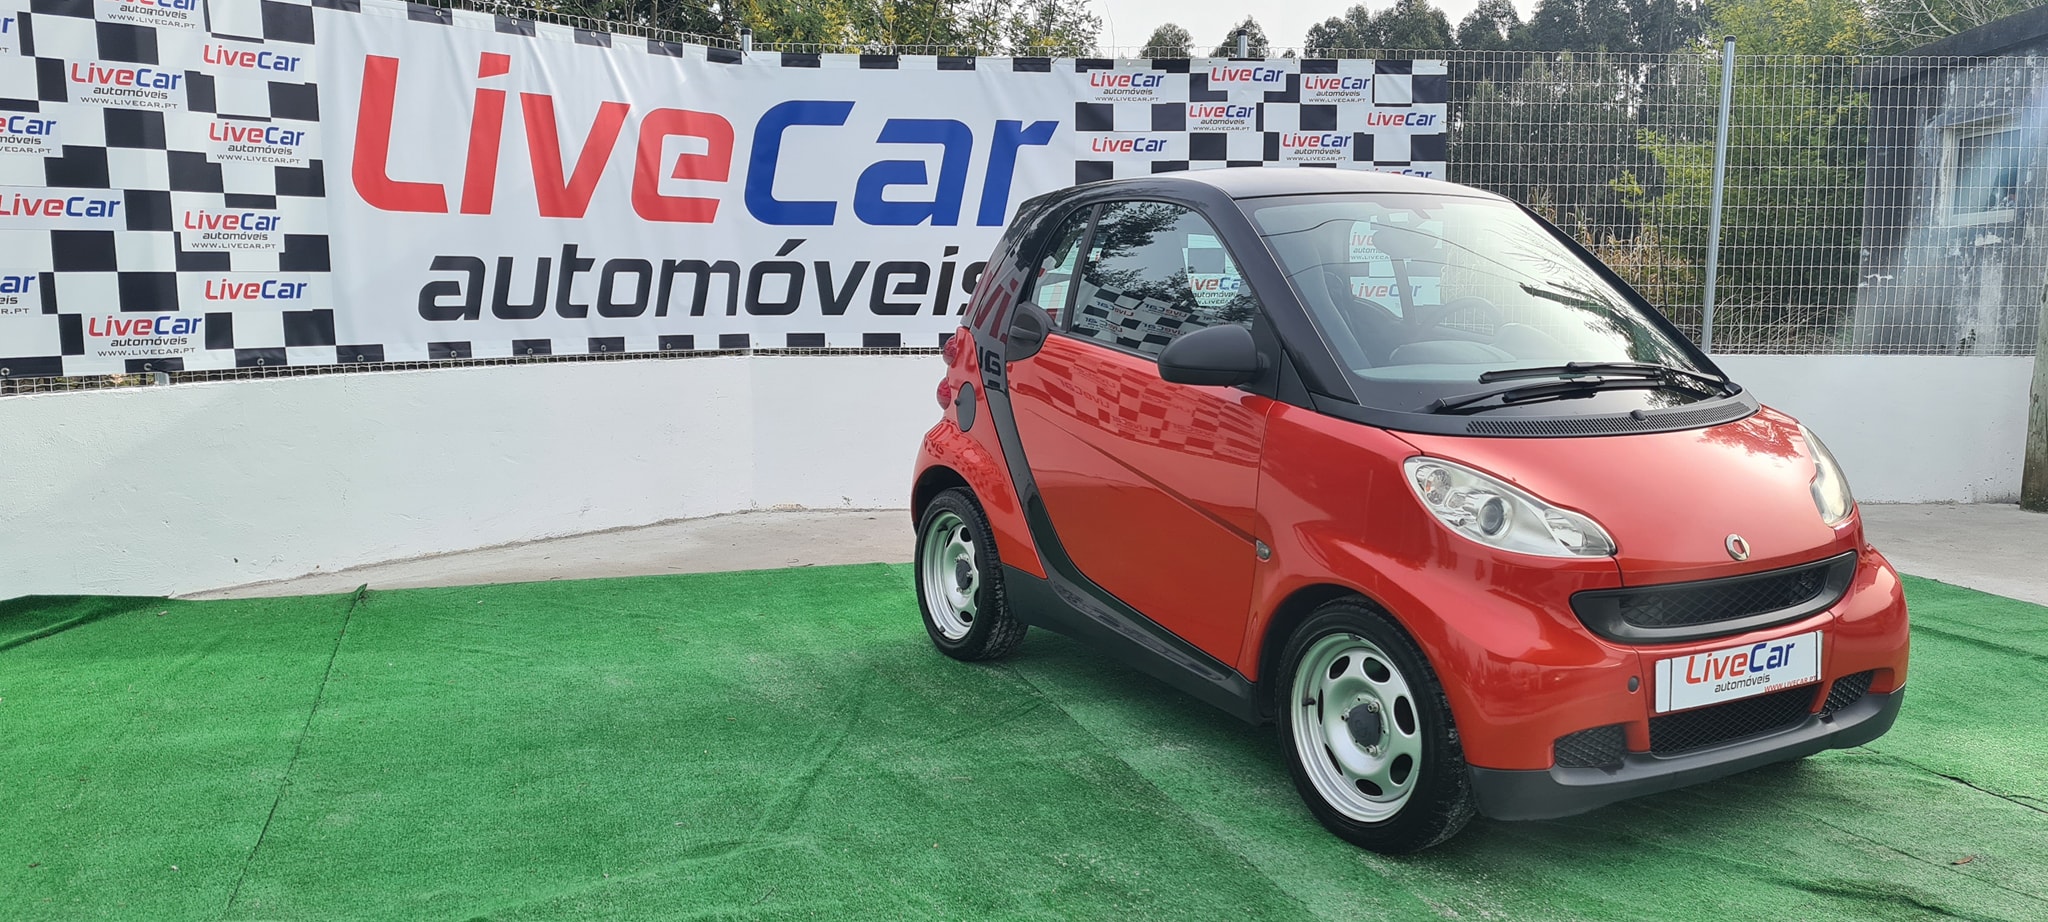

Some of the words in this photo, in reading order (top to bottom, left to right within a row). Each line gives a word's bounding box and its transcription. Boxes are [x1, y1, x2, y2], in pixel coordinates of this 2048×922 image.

[120, 5, 187, 19] automóveis
[108, 14, 195, 29] WWW.LIVECAR.PT
[203, 45, 300, 72] LiveCar
[71, 63, 182, 90] LiveCar
[1090, 72, 1164, 87] LiveCar
[1211, 66, 1283, 82] LiveCar
[1305, 75, 1370, 90] LiveCar
[93, 87, 168, 99] automóveis
[80, 97, 178, 109] WWW.LIVECAR.PT
[1189, 104, 1254, 118] LiveCar
[1367, 112, 1437, 126] LiveCar
[209, 122, 305, 146] LiveCar
[352, 51, 1059, 227] LiveCar
[1282, 132, 1351, 147] LiveCar
[228, 145, 293, 155] automóveis
[1092, 137, 1167, 152] LiveCar
[217, 154, 300, 164] WWW.LIVECAR.PT
[184, 210, 281, 231] LiveCar
[203, 231, 268, 240] automóveis
[205, 278, 307, 299] LiveCar
[88, 315, 202, 337] LiveCar
[111, 335, 188, 347] automóveis
[97, 347, 196, 357] WWW.LIVECAR.PT
[1686, 643, 1795, 685] LiveCar
[1714, 673, 1771, 693] automóveis
